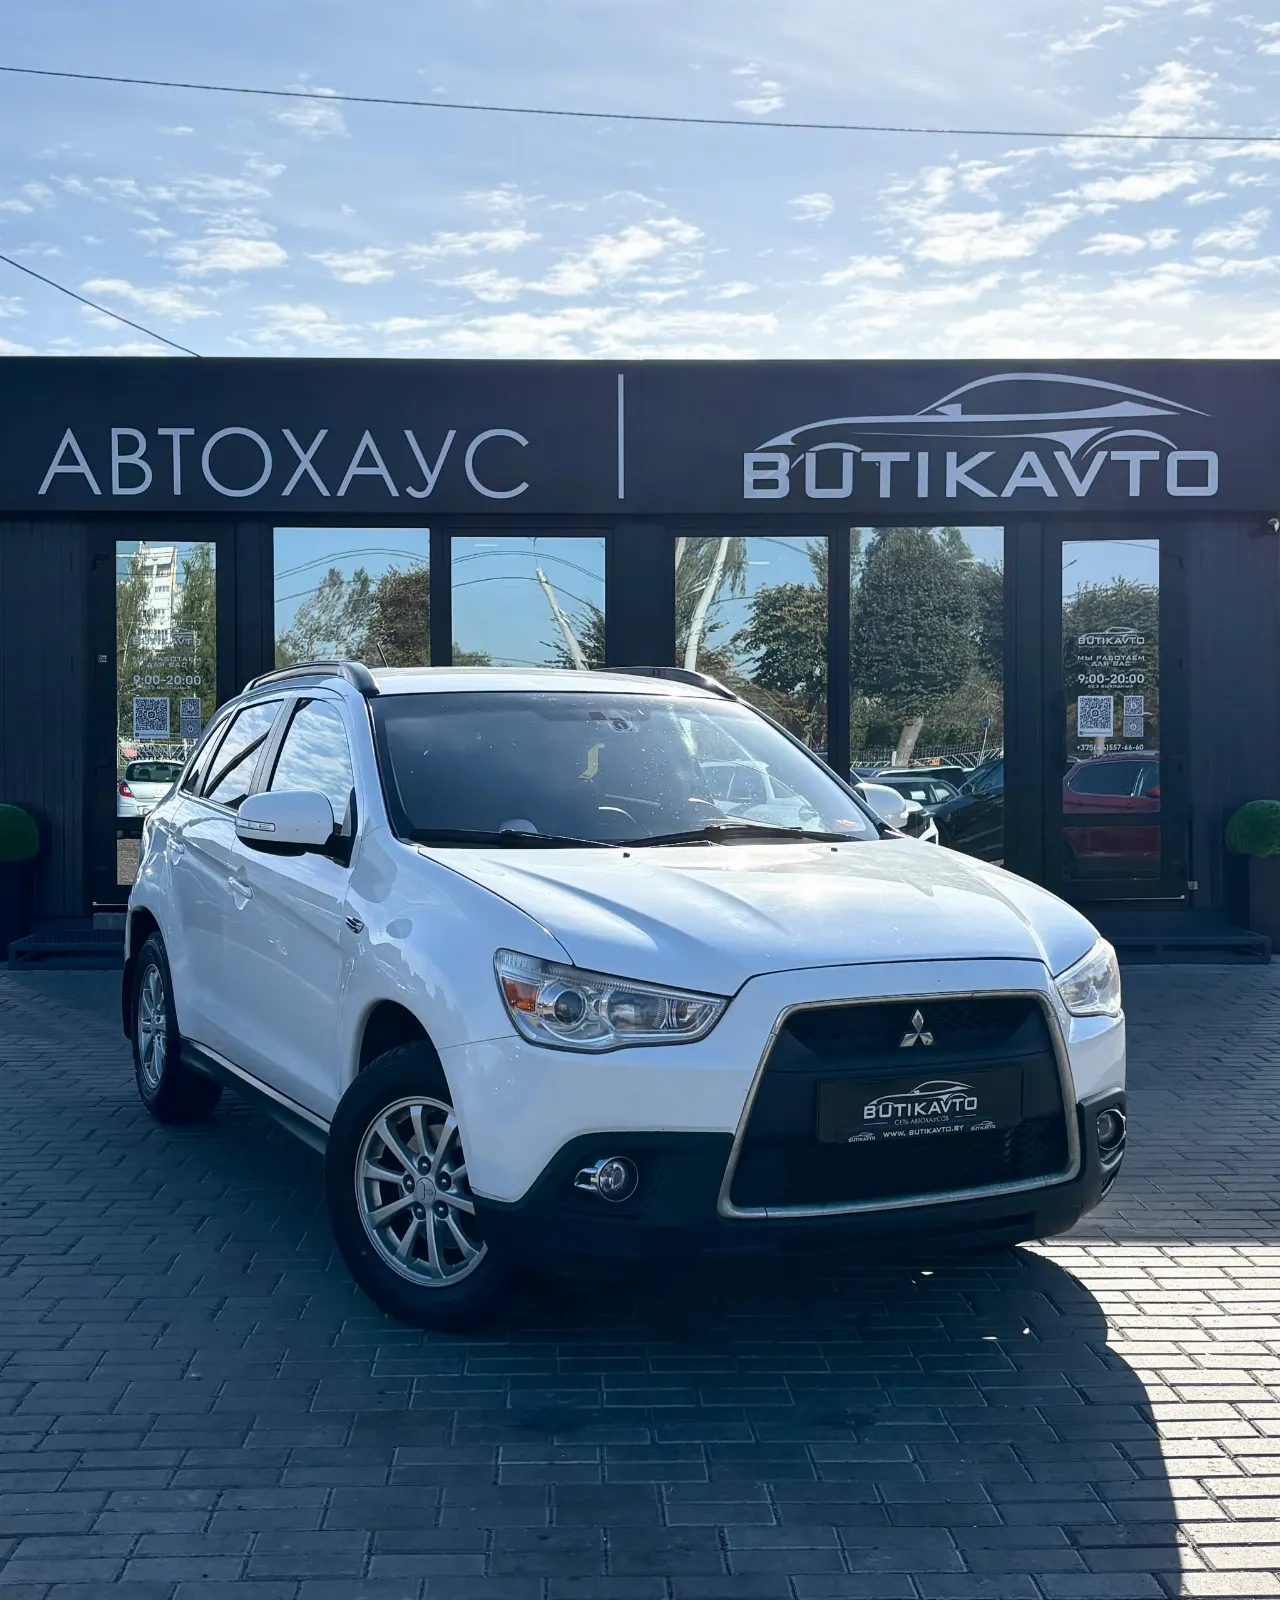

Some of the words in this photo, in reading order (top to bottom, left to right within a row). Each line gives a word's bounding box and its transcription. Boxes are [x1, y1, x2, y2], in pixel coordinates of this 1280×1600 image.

[38, 427, 530, 499] АВТОХАУС
[743, 450, 1219, 499] BUTIKAVTO
[1078, 637, 1145, 645] BUTIKAVTO
[133, 675, 201, 686] 9:00-20:00
[1077, 674, 1145, 684] 9:00-20:00
[863, 1097, 977, 1119] BUTIKAVTO
